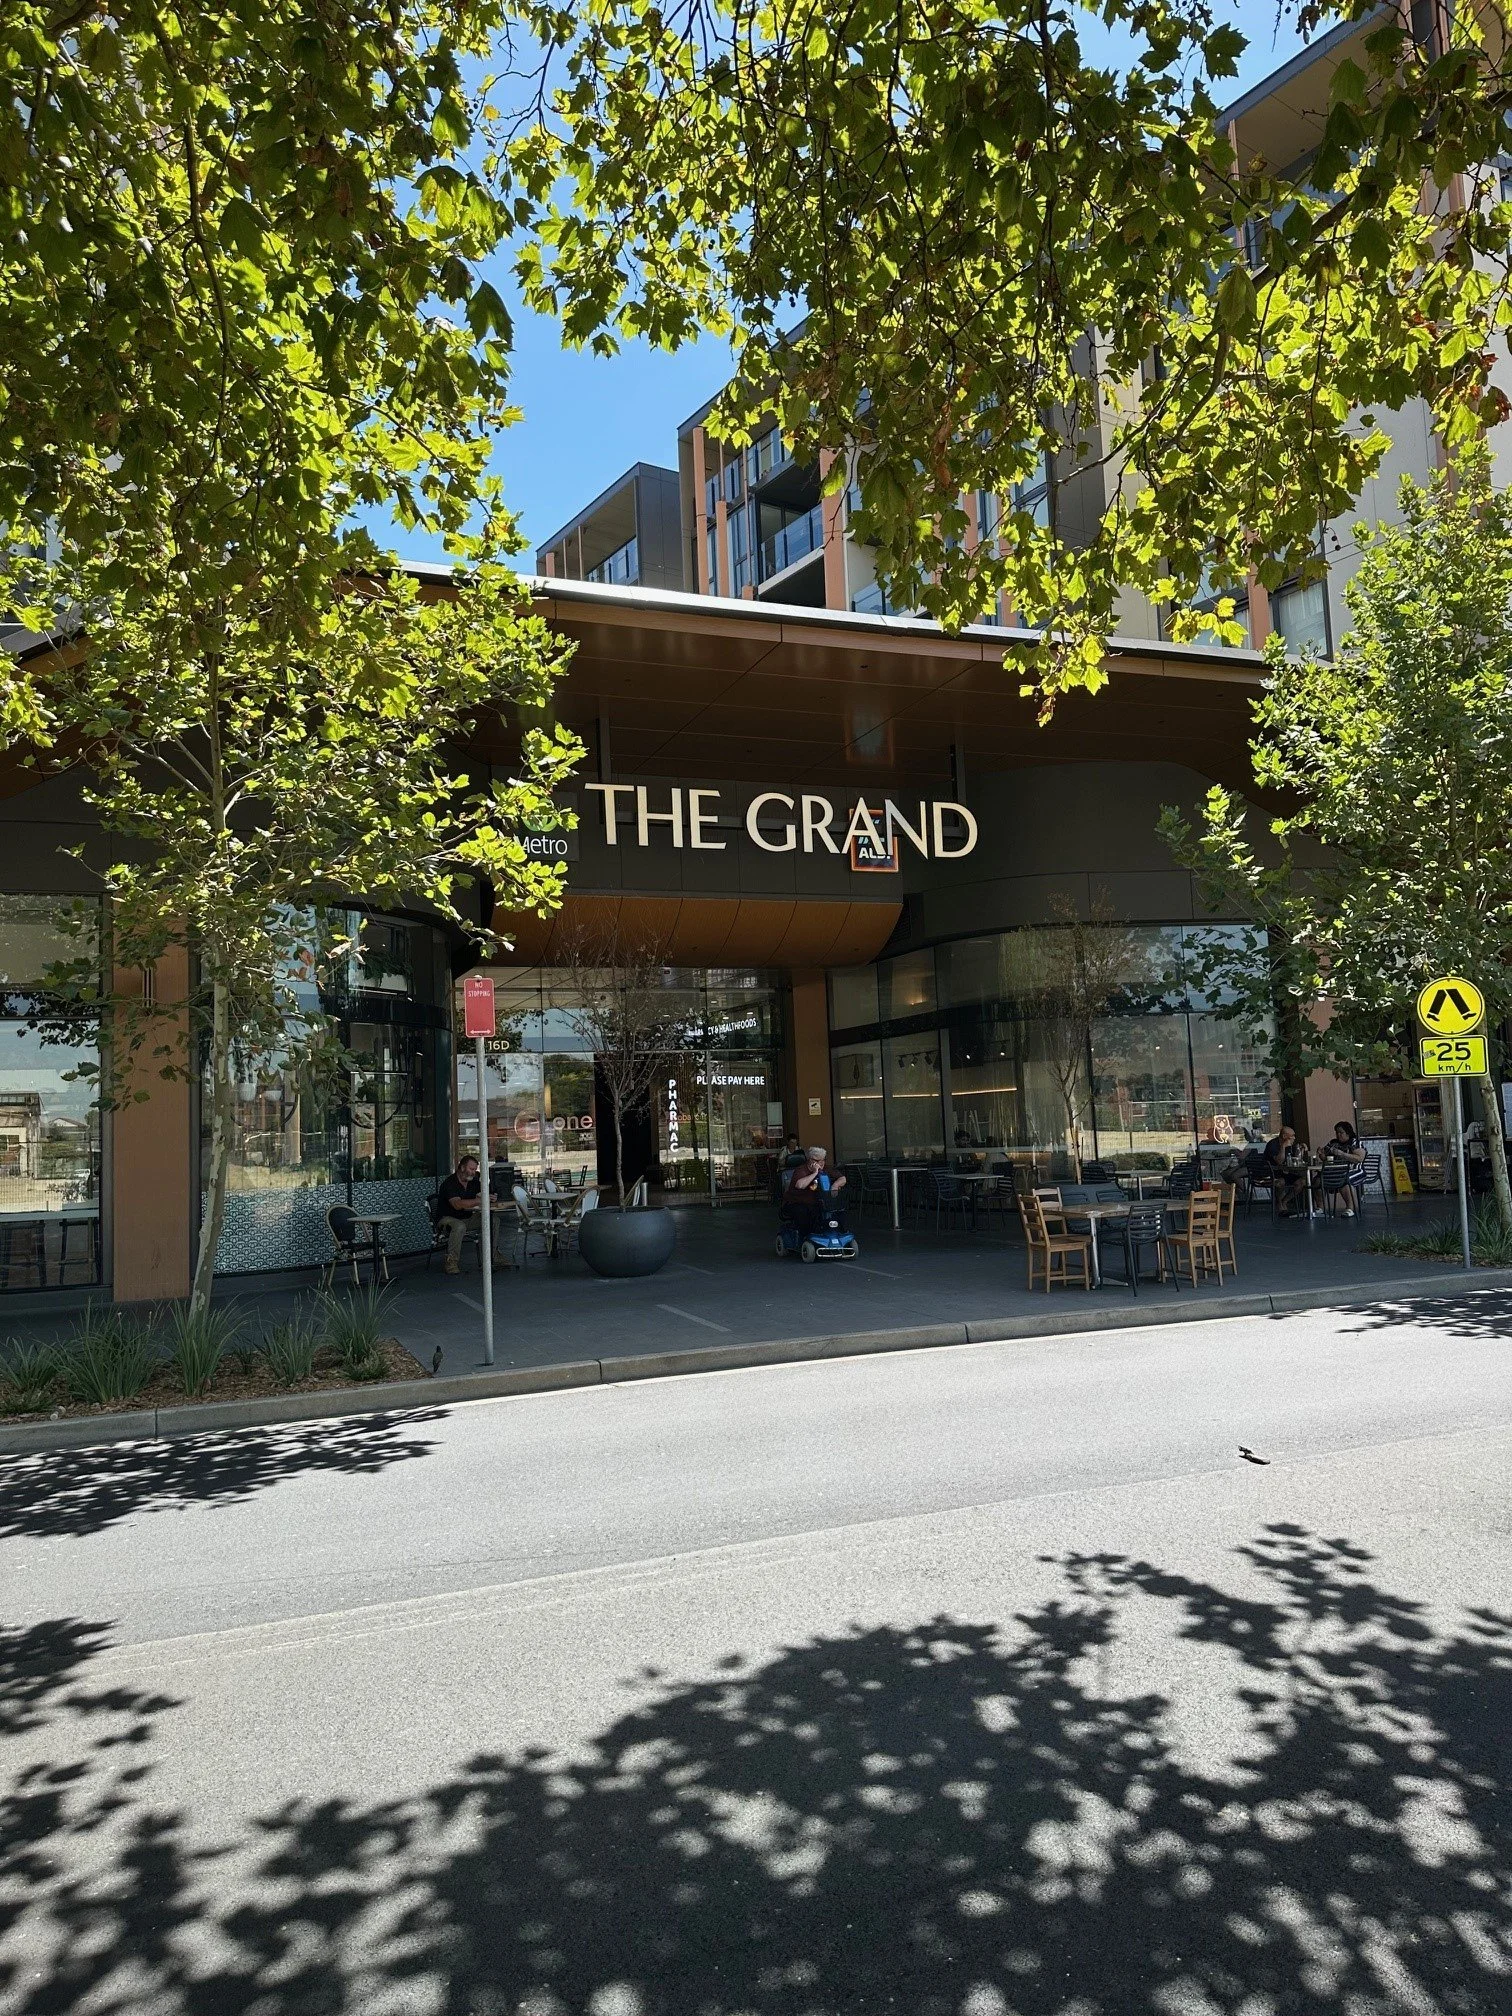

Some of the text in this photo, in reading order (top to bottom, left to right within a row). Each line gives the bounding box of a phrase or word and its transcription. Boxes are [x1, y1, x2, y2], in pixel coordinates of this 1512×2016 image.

[585, 783, 978, 860] THE GRAND
[487, 1040, 510, 1050] 16D
[1436, 1042, 1471, 1061] 25
[1438, 1062, 1471, 1073] km/h
[696, 1075, 765, 1085] PLASE PAY HERE
[668, 1079, 679, 1162] PHARMAC
